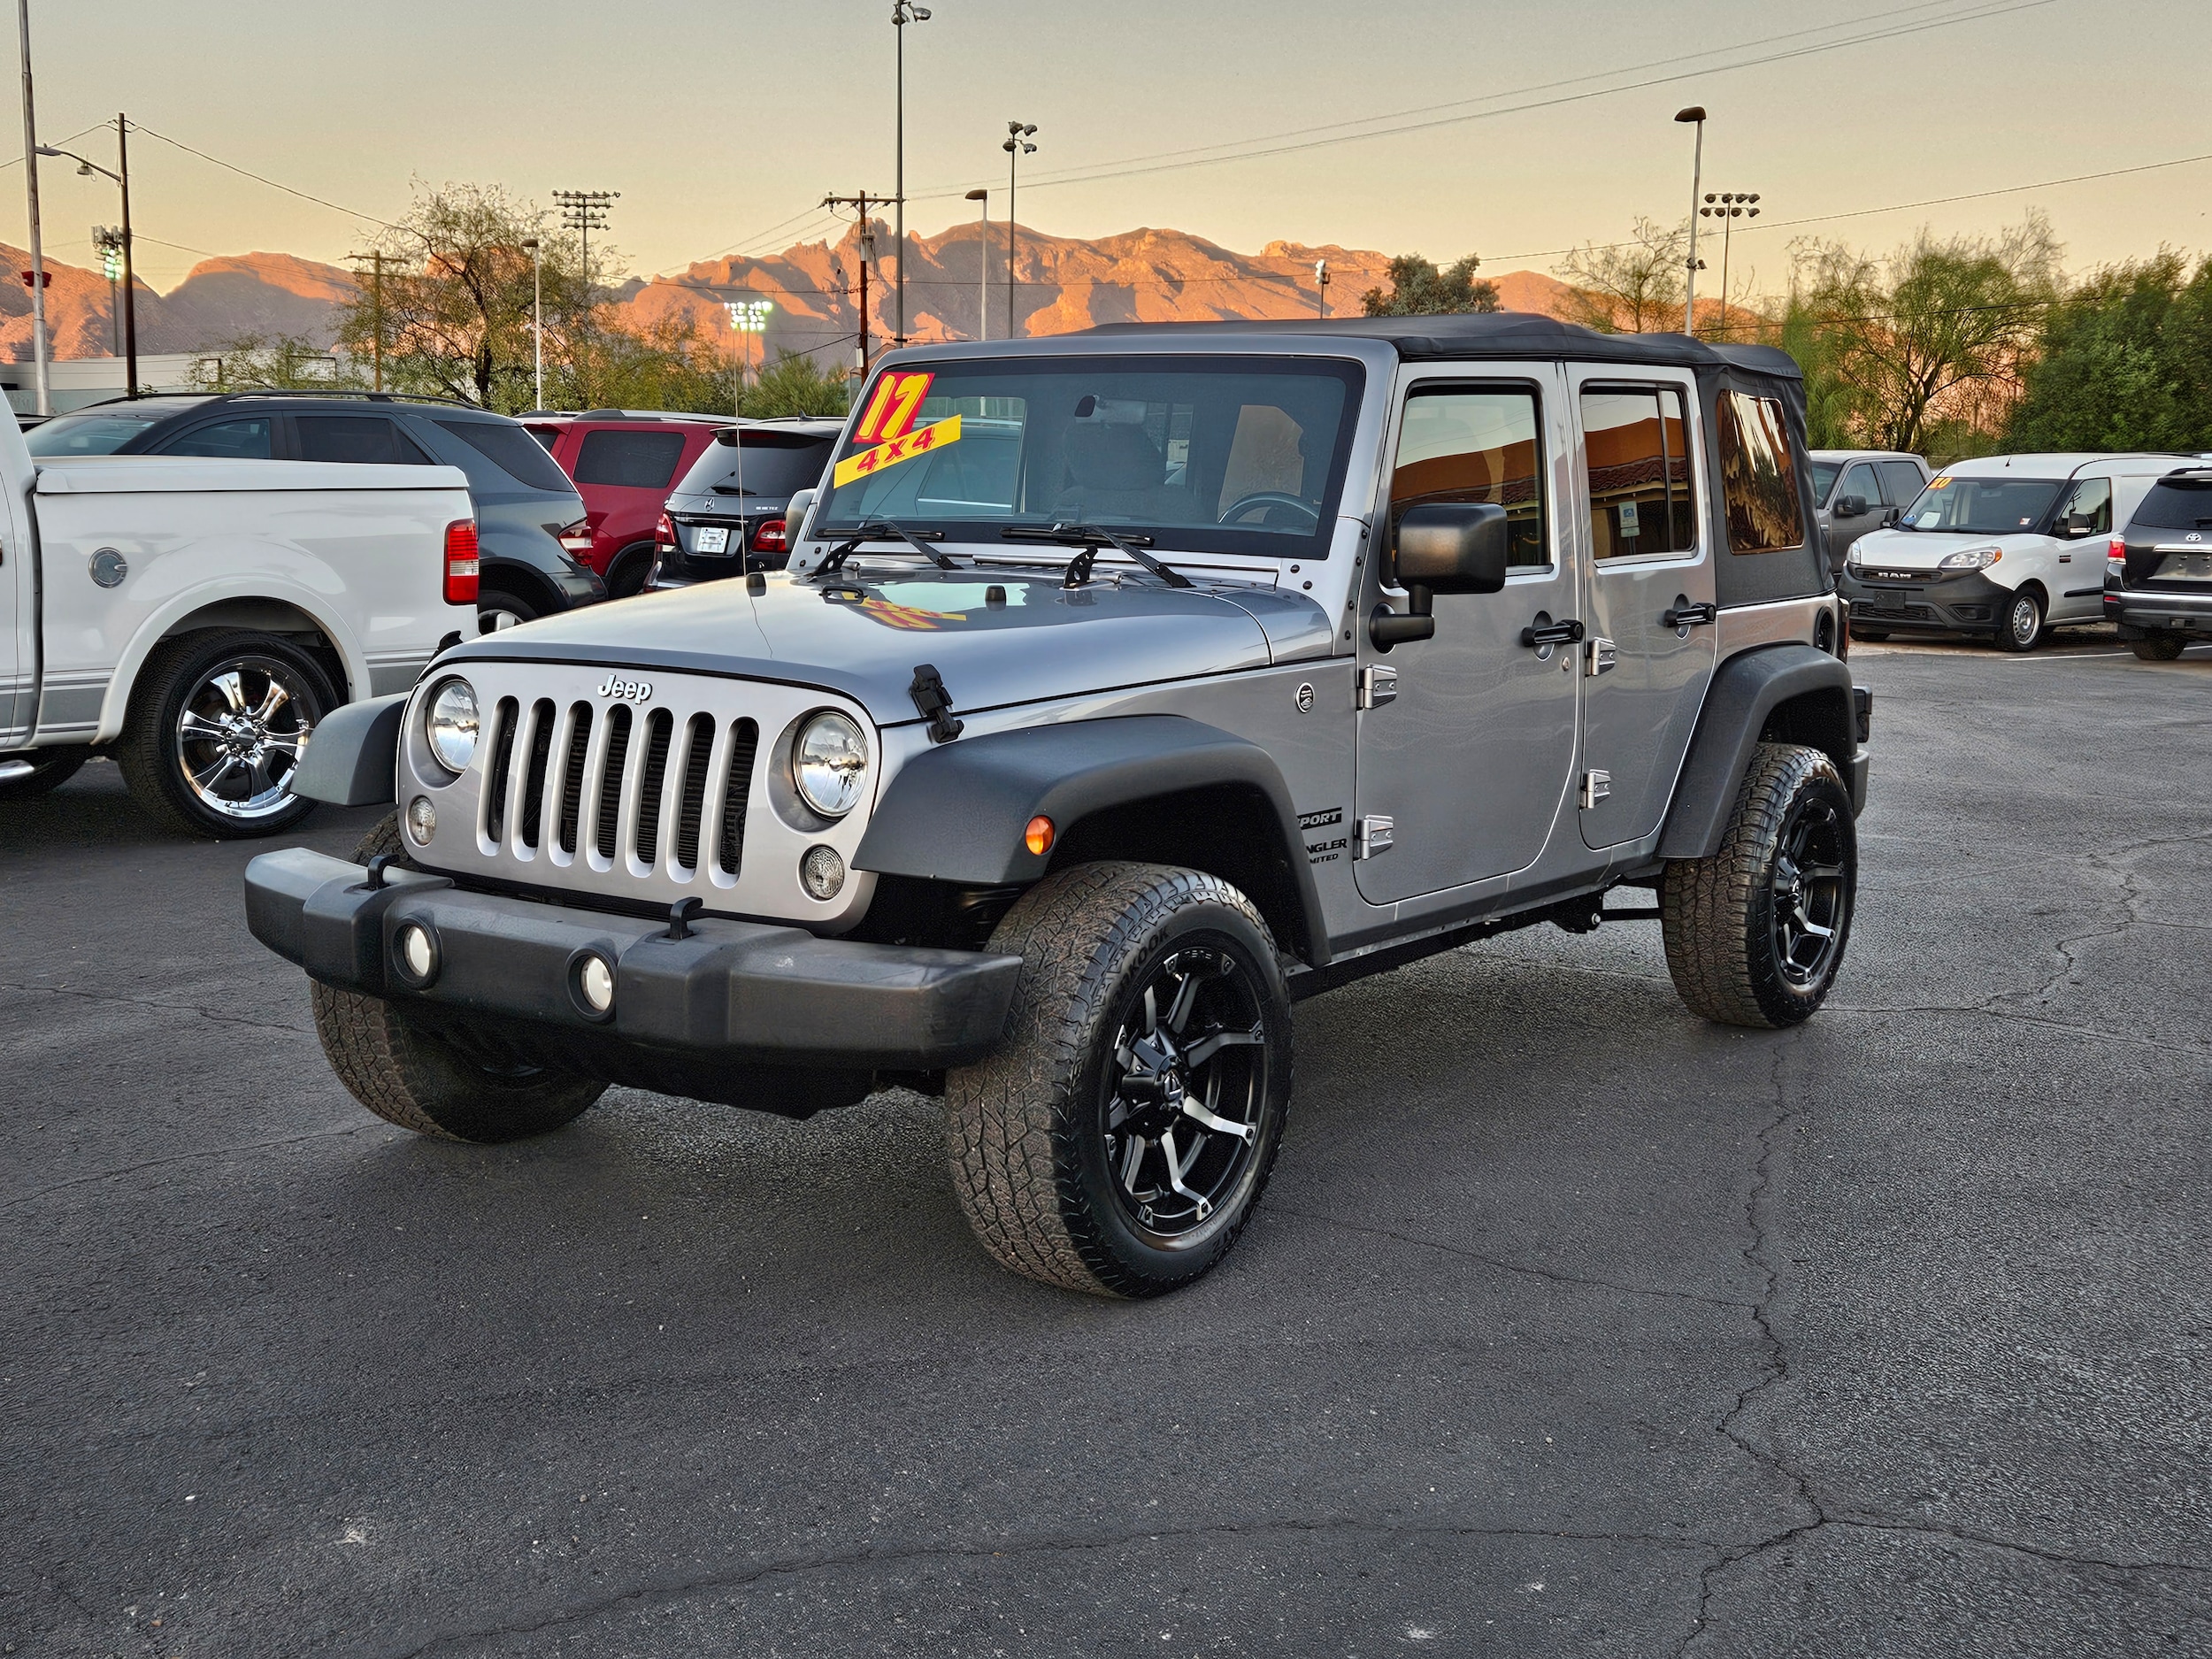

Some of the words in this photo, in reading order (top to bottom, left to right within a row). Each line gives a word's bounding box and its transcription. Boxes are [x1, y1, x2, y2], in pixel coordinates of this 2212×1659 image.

[858, 373, 929, 442] 17
[597, 673, 653, 705] Jeep
[1298, 810, 1342, 827] PORT
